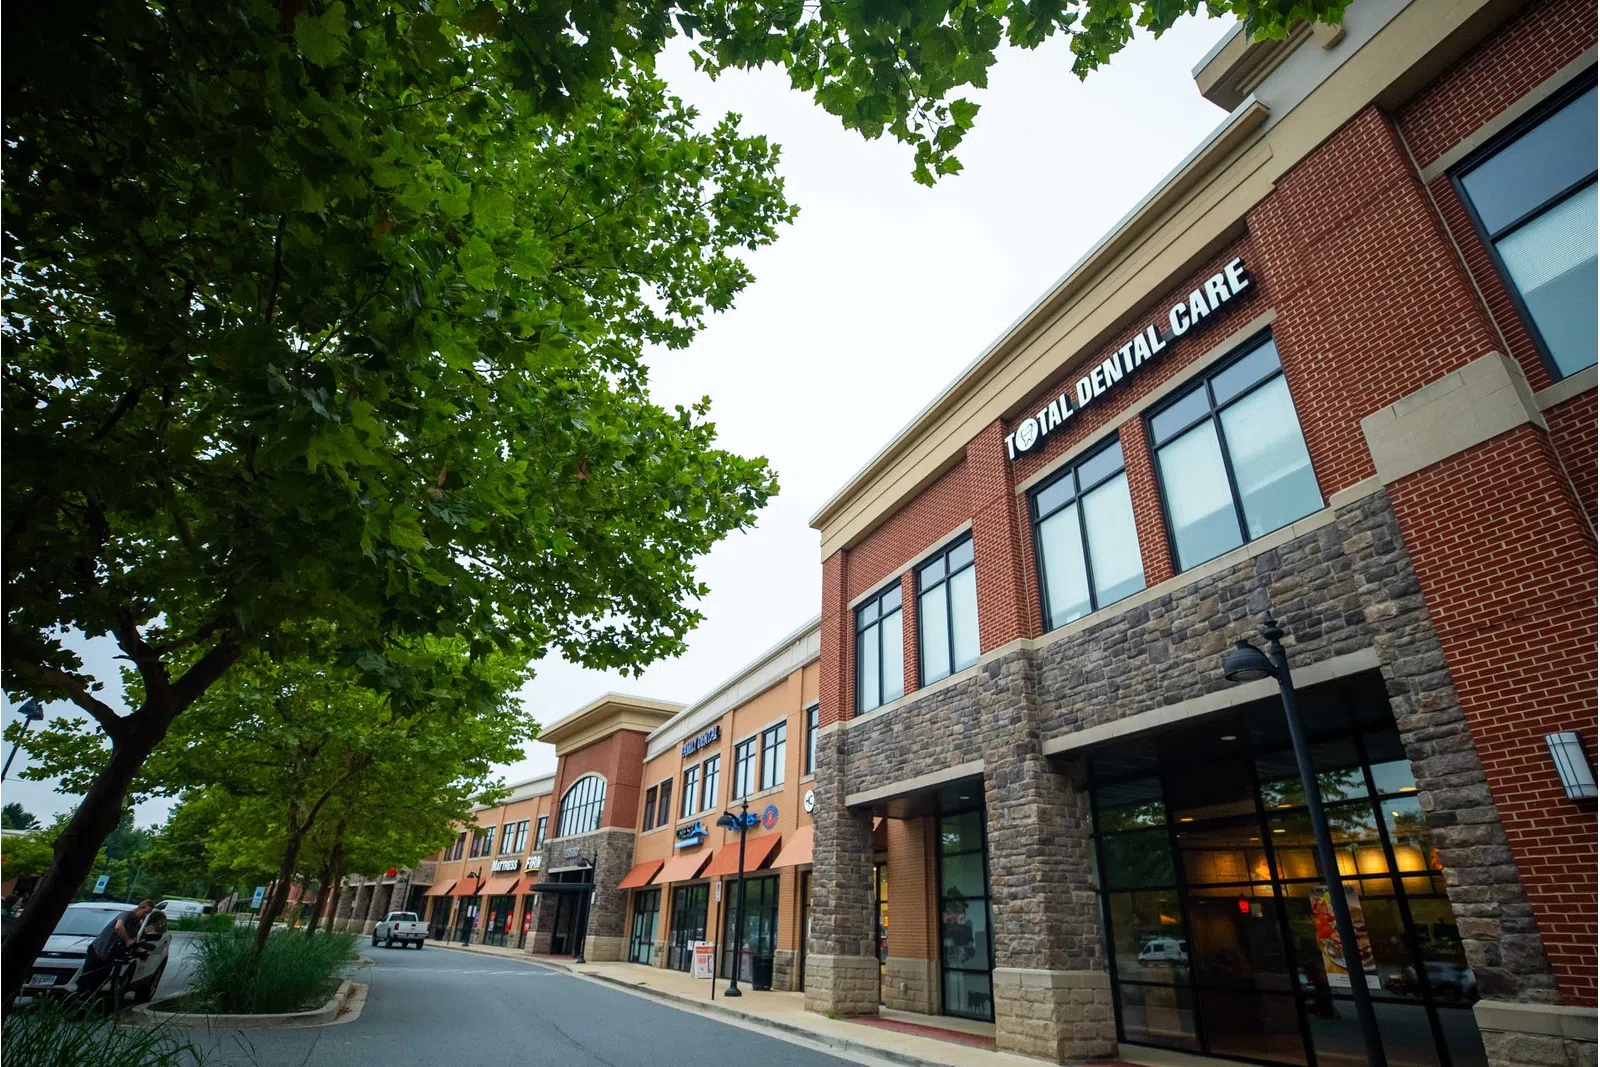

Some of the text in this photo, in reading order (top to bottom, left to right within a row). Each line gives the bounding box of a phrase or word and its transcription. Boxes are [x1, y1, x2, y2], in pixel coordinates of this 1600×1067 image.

[1005, 258, 1249, 460] TOTAL DENTAL CARE
